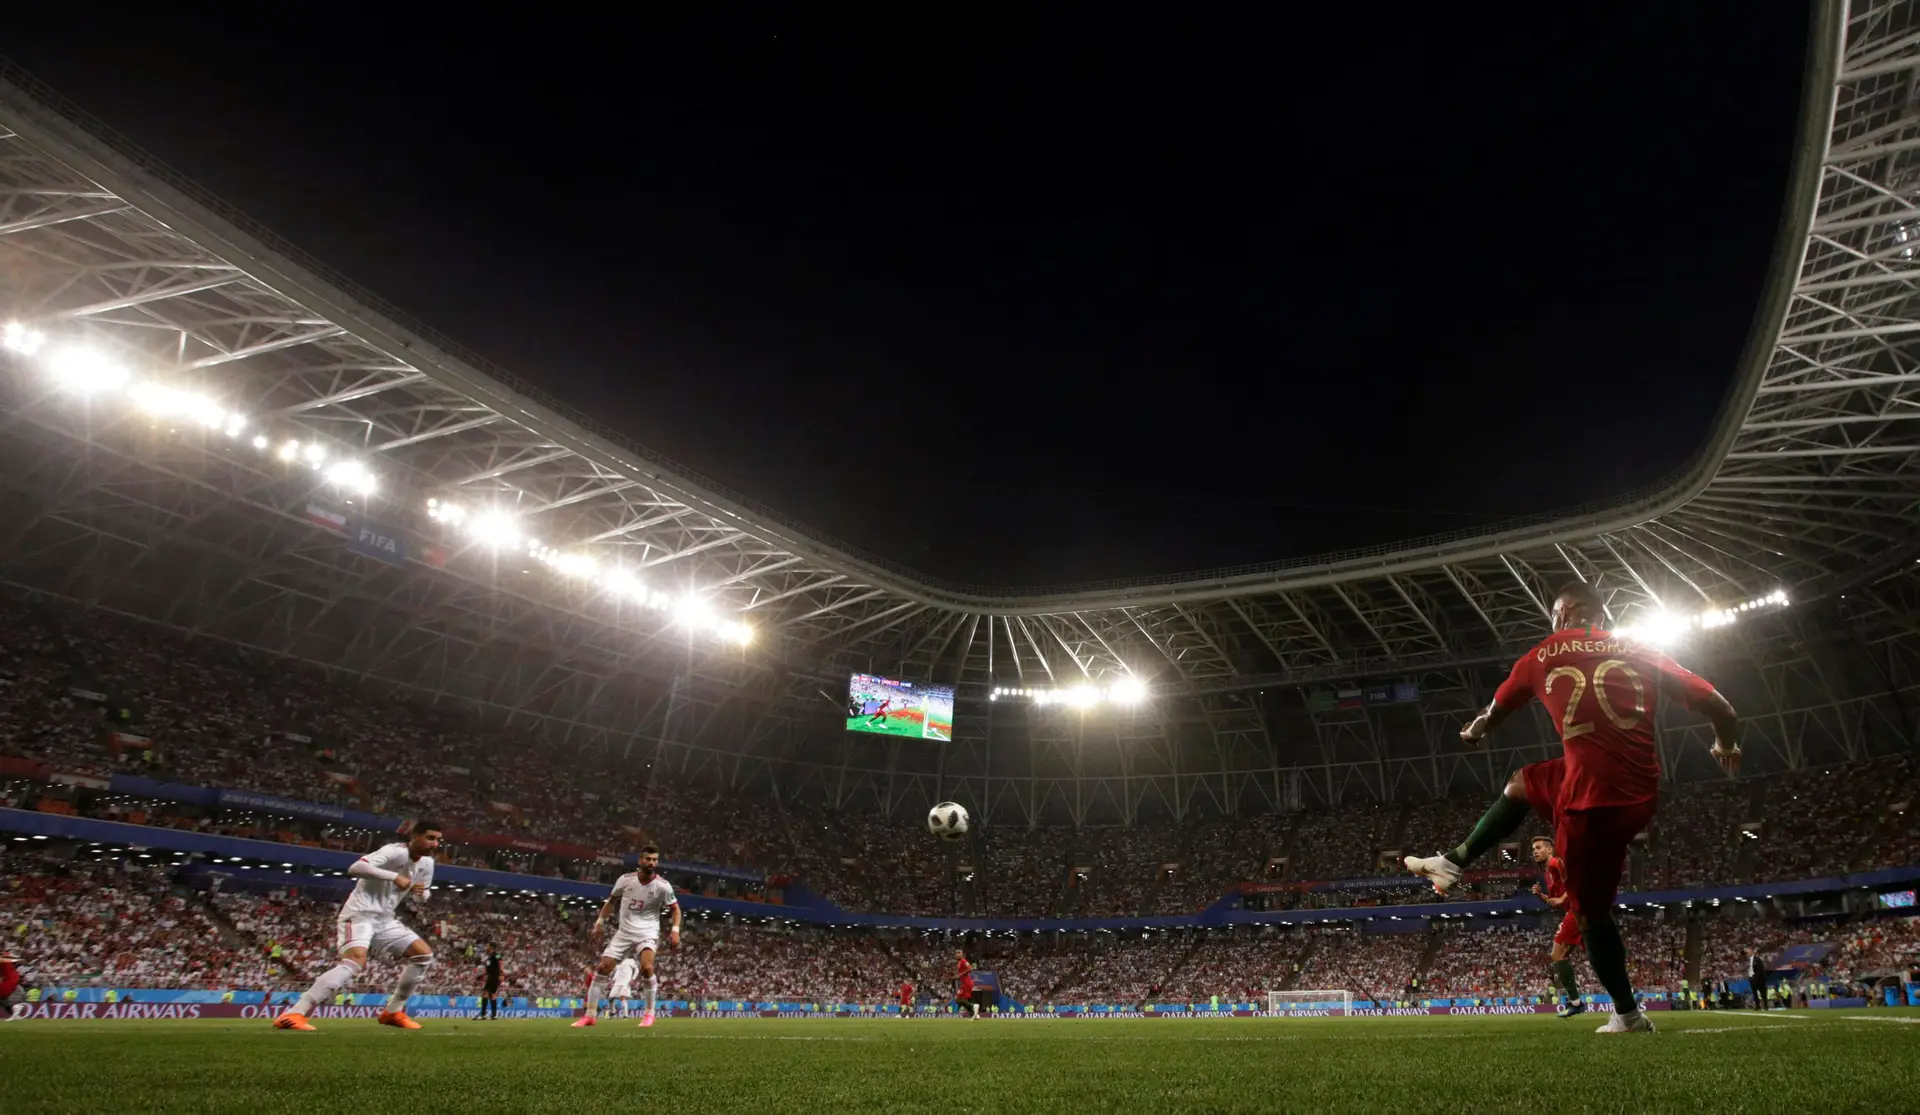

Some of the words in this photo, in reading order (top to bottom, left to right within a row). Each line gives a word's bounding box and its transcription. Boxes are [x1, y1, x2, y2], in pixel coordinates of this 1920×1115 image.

[359, 528, 396, 553] FIFA
[1537, 639, 1636, 663] QUARESMA
[1545, 659, 1646, 741] 20
[628, 899, 645, 911] 23
[101, 1003, 200, 1019] AIRWAYS
[241, 1005, 298, 1019] QAT
[1350, 1008, 1383, 1017] QATAR
[1386, 1007, 1430, 1016] AIRWAYS
[1449, 1006, 1486, 1015] QATAR
[1488, 1005, 1535, 1015] AIRWAYS
[1597, 1001, 1647, 1013] AIRS
[415, 1009, 440, 1018] 2018
[441, 1009, 464, 1018] FIFA
[504, 1009, 526, 1018] CUP
[691, 1010, 722, 1019] QATAR
[725, 1010, 762, 1019] AIRWAYS
[991, 1011, 1021, 1019] QATAR
[1076, 1011, 1107, 1019] QATAR
[1108, 1011, 1144, 1019] AIRWAYS
[1162, 1010, 1193, 1019] QATAR
[1195, 1010, 1235, 1019] AIRWAYS
[1252, 1009, 1285, 1017] QATAR
[1287, 1009, 1330, 1017] AIRWAYS
